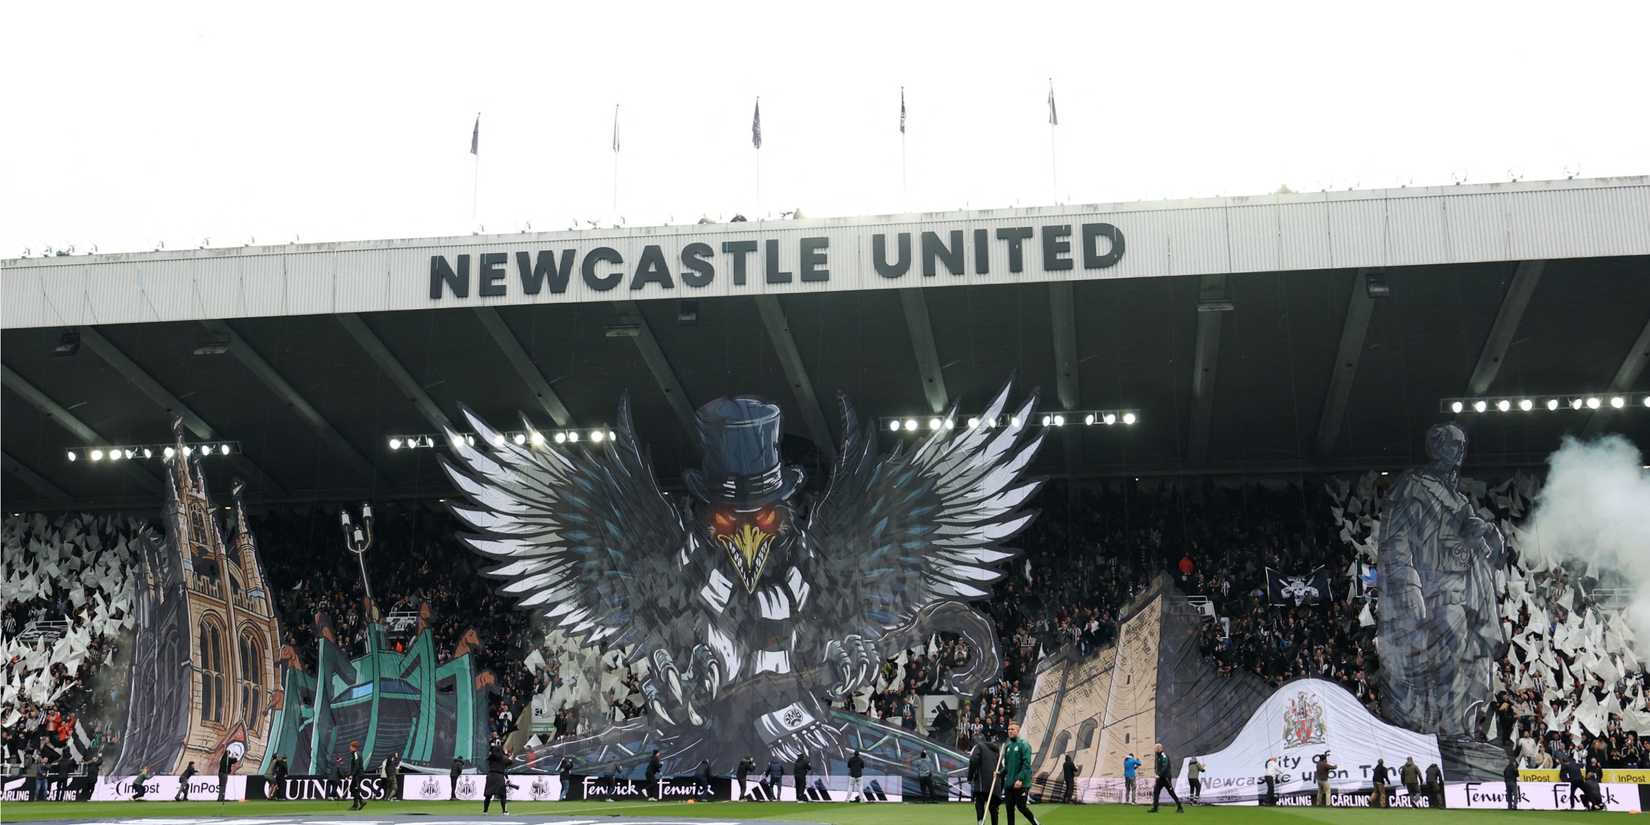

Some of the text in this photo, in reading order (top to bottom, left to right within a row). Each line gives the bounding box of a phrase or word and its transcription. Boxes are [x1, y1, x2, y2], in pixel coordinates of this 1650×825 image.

[429, 222, 1126, 300] NEWCASTLE UNITED
[1200, 772, 1291, 790] Newcasle
[1523, 774, 1551, 783] InPost
[1618, 774, 1647, 784] InPost
[124, 782, 160, 794] Inost
[190, 782, 220, 794] InPos
[264, 778, 385, 800] UINNSS
[1464, 782, 1530, 806] Fenwk
[1276, 795, 1312, 806] ARLING
[1389, 795, 1429, 808] CARLNG
